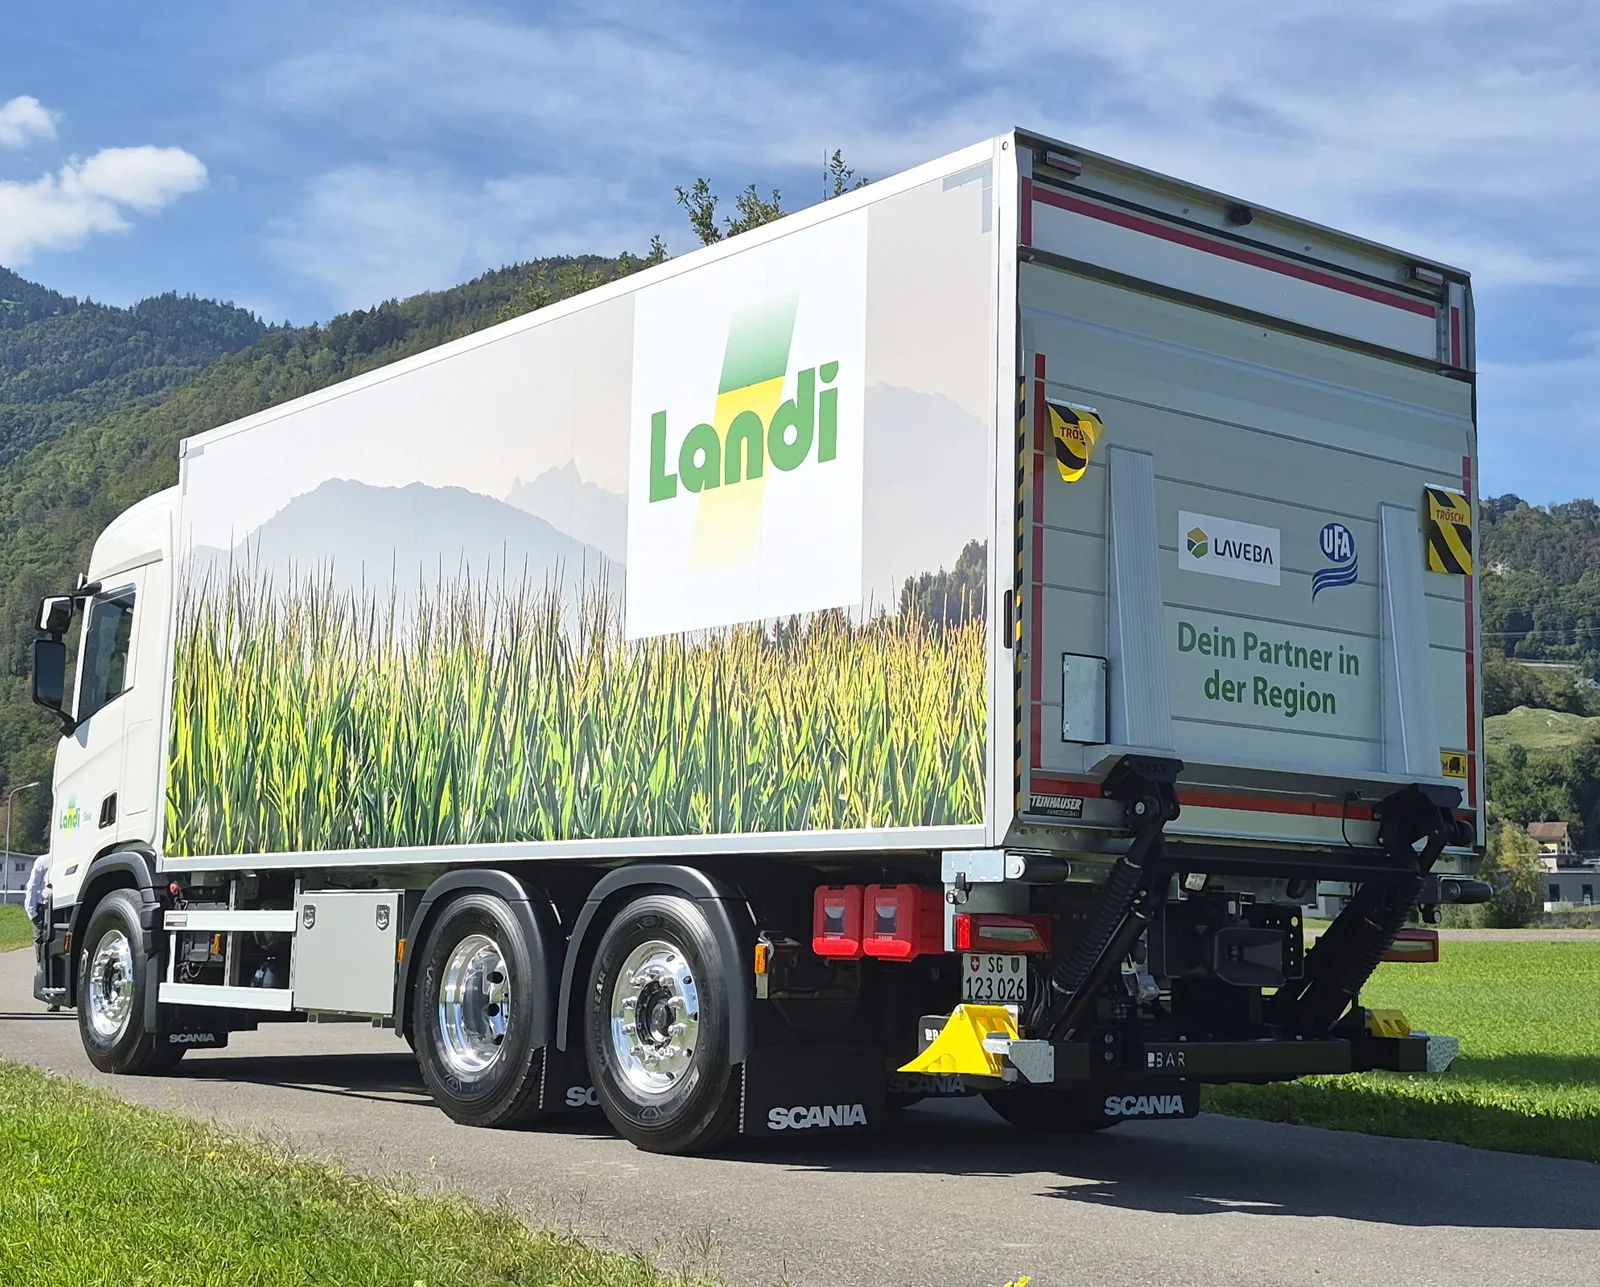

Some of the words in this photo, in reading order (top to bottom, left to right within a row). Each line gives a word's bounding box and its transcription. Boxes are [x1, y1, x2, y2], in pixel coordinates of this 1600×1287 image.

[649, 360, 839, 503] Landi
[1060, 426, 1086, 441] TRÖS
[1214, 537, 1274, 565] LAVEBA
[1323, 525, 1351, 560] UFA
[1178, 621, 1236, 659] Dein
[1243, 631, 1333, 672] Partner
[1338, 645, 1360, 676] in
[1204, 669, 1247, 703] der
[1253, 675, 1336, 718] Region
[1030, 795, 1082, 811] TEINHAUSER
[59, 807, 81, 830] Landi
[988, 956, 1003, 974] SG
[169, 1033, 215, 1044] SCANIA
[766, 1104, 868, 1130] SCANIA
[1103, 1095, 1185, 1116] SCANIA
